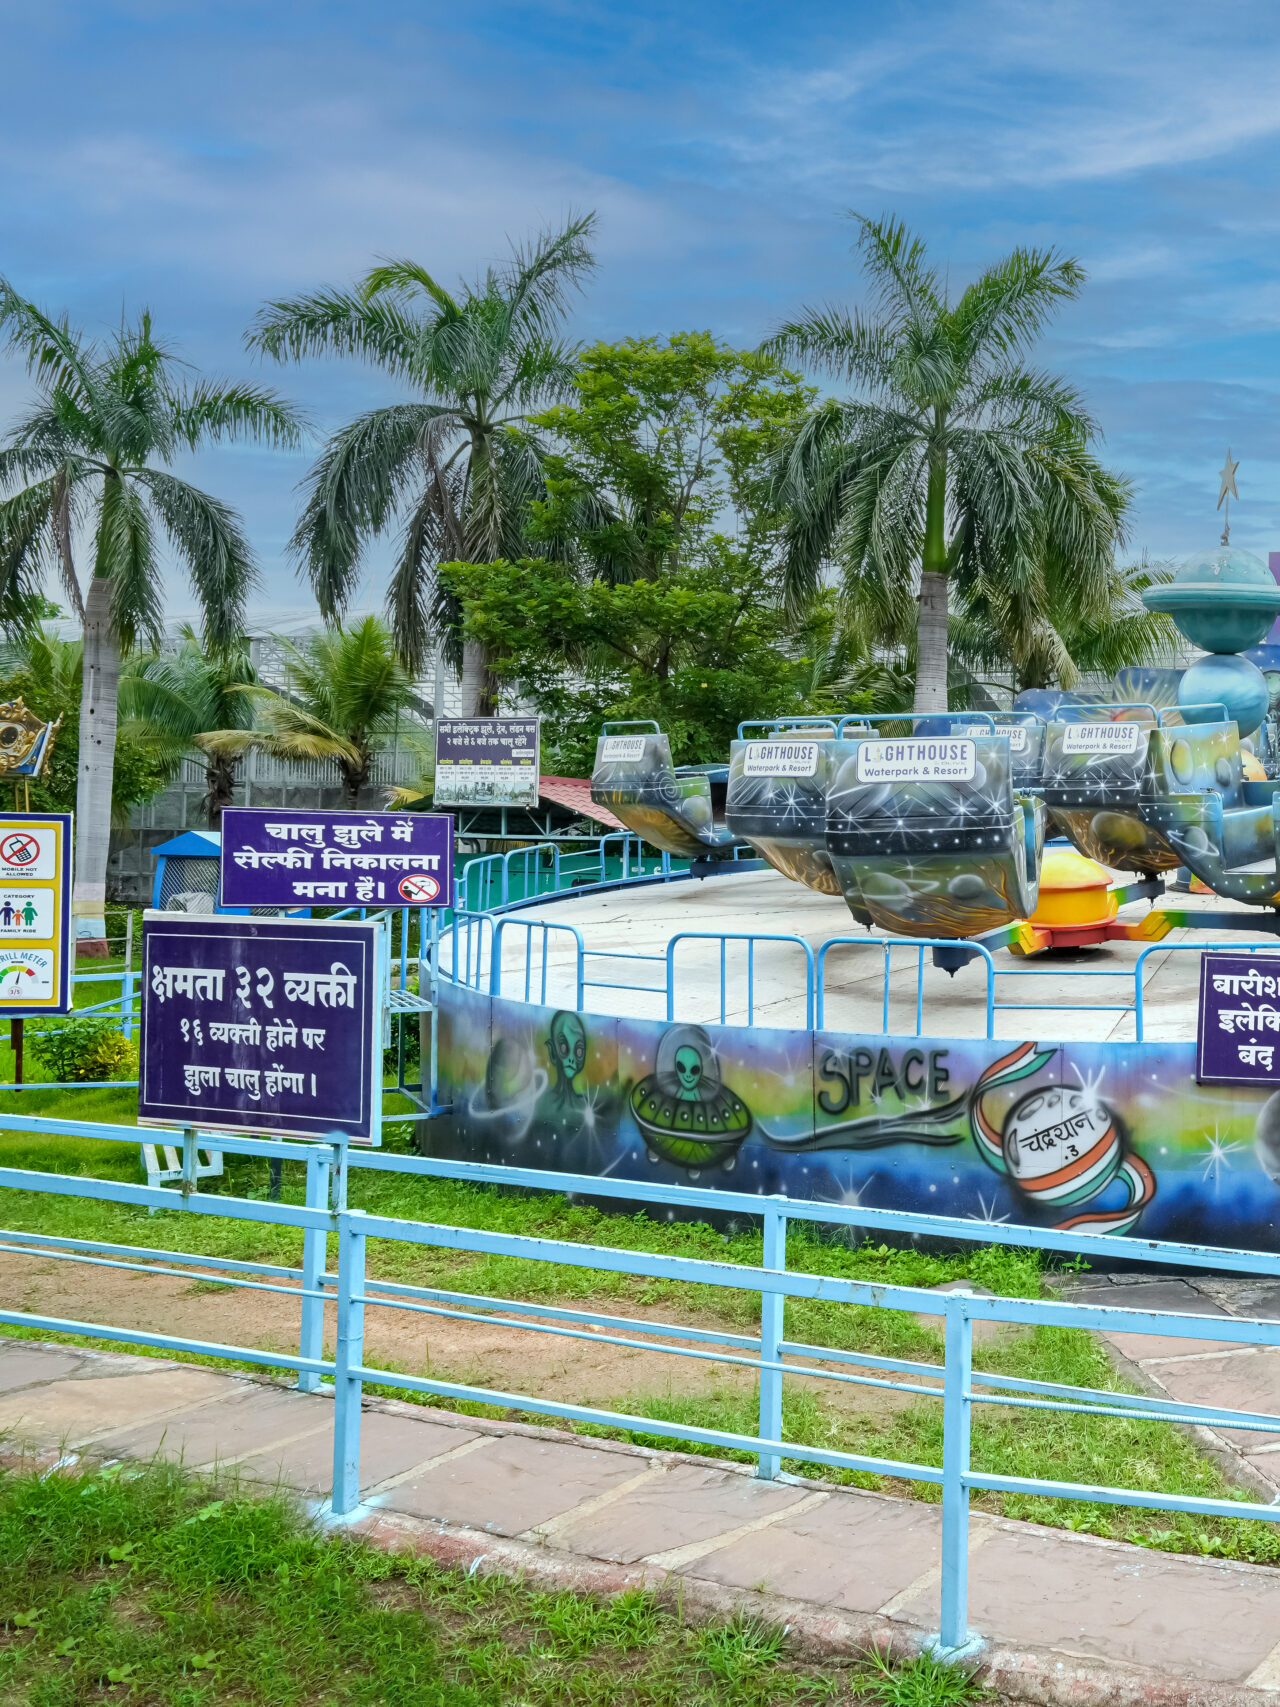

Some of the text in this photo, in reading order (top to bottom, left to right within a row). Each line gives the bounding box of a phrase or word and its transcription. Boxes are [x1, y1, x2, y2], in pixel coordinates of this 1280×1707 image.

[865, 745, 967, 762] LIGHTHOUSE
[865, 767, 967, 777] Waterpark & Resort
[265, 820, 414, 848] चालु झुले में
[233, 846, 440, 870] सेल्फी निकालना
[293, 882, 348, 898] मना
[20, 952, 47, 968] METER
[152, 962, 357, 1008] क्षमता ३२ व्यक्ती
[180, 1017, 326, 1051] १६ व्यक्ती होने पर
[1238, 1038, 1274, 1071] बंद
[184, 1065, 221, 1095] झुला
[225, 1068, 260, 1100] चालु
[264, 1063, 304, 1097] होंगा
[817, 1046, 949, 1116] SPACE
[1019, 1109, 1095, 1151] चंद्रयान
